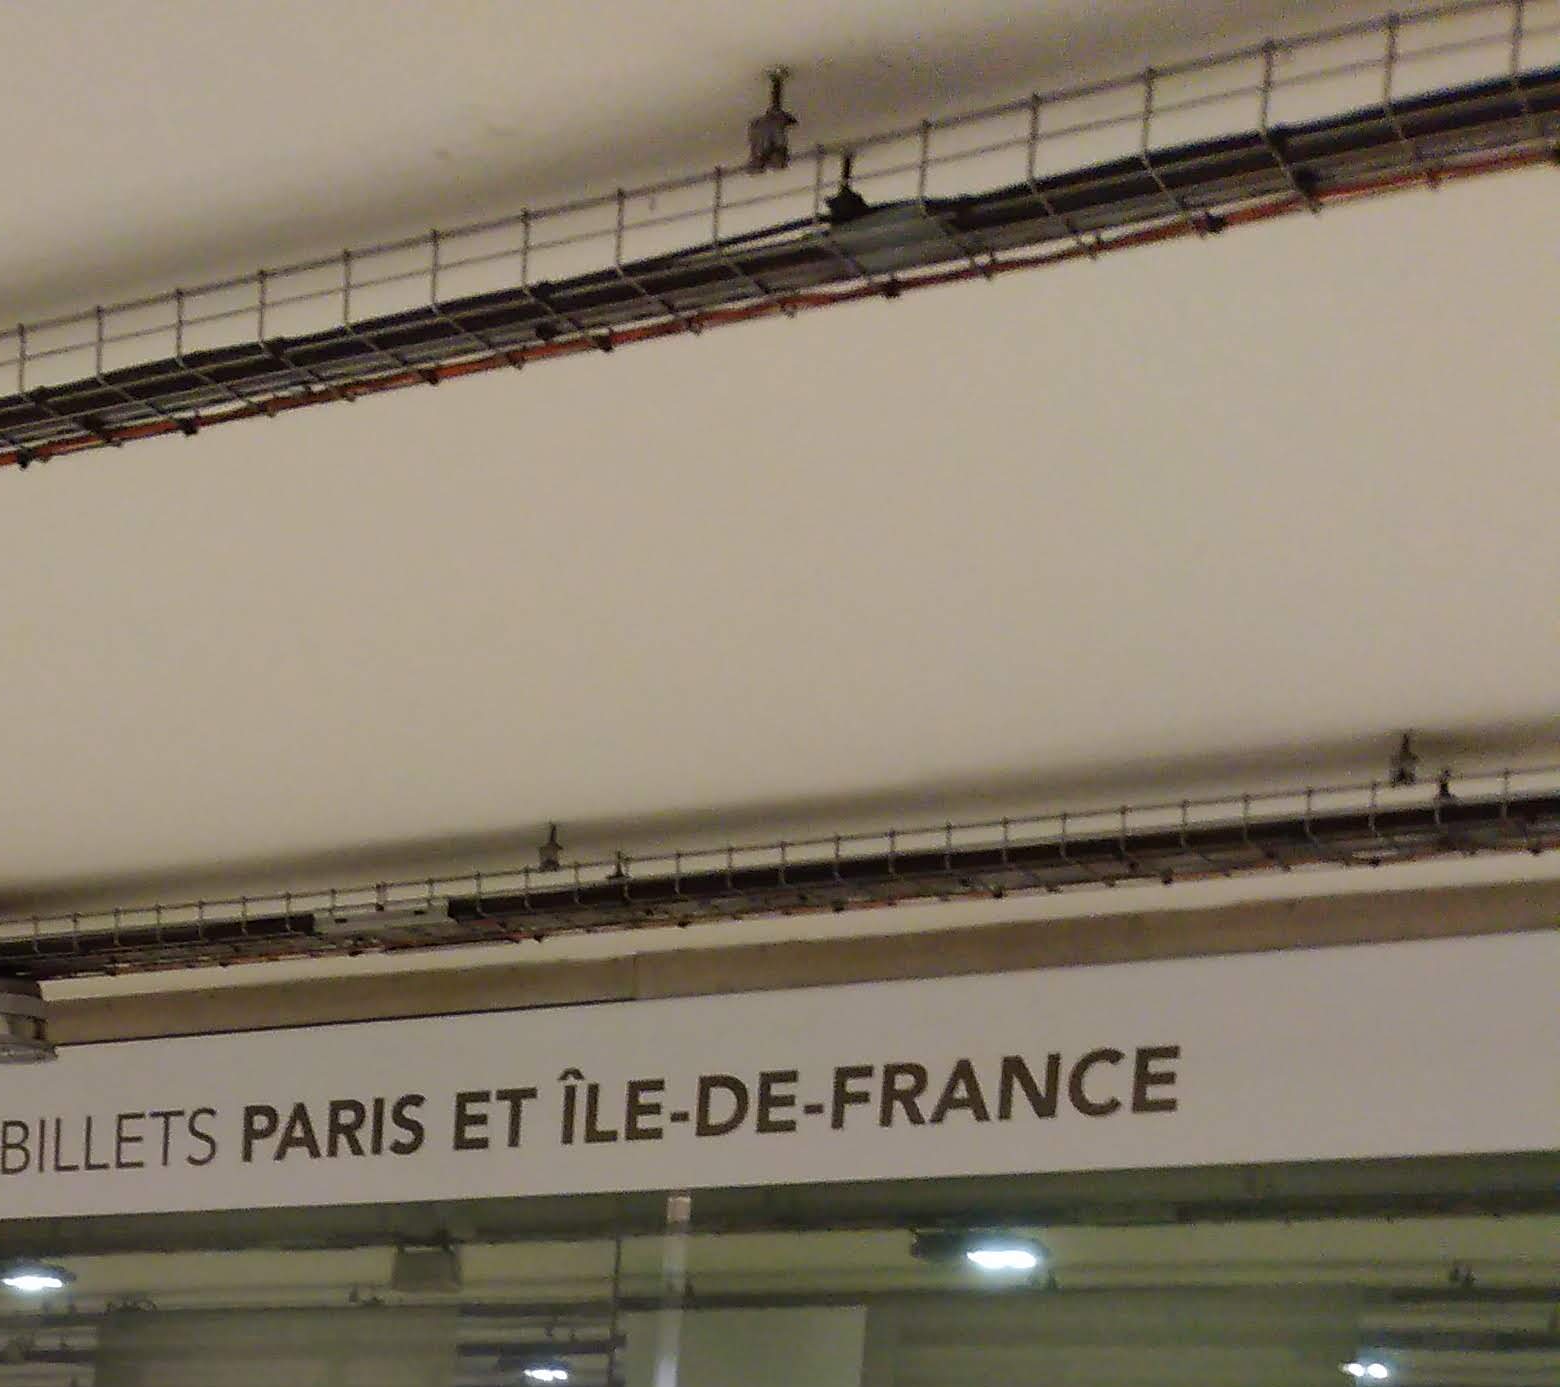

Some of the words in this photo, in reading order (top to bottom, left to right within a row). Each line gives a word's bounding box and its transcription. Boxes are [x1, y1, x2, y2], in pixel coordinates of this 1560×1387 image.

[1, 1107, 217, 1175] BILLETS
[241, 1093, 426, 1162] PARIS
[453, 1087, 538, 1151] ET
[558, 1045, 1182, 1145] ÎLE-DE-FRANCE
